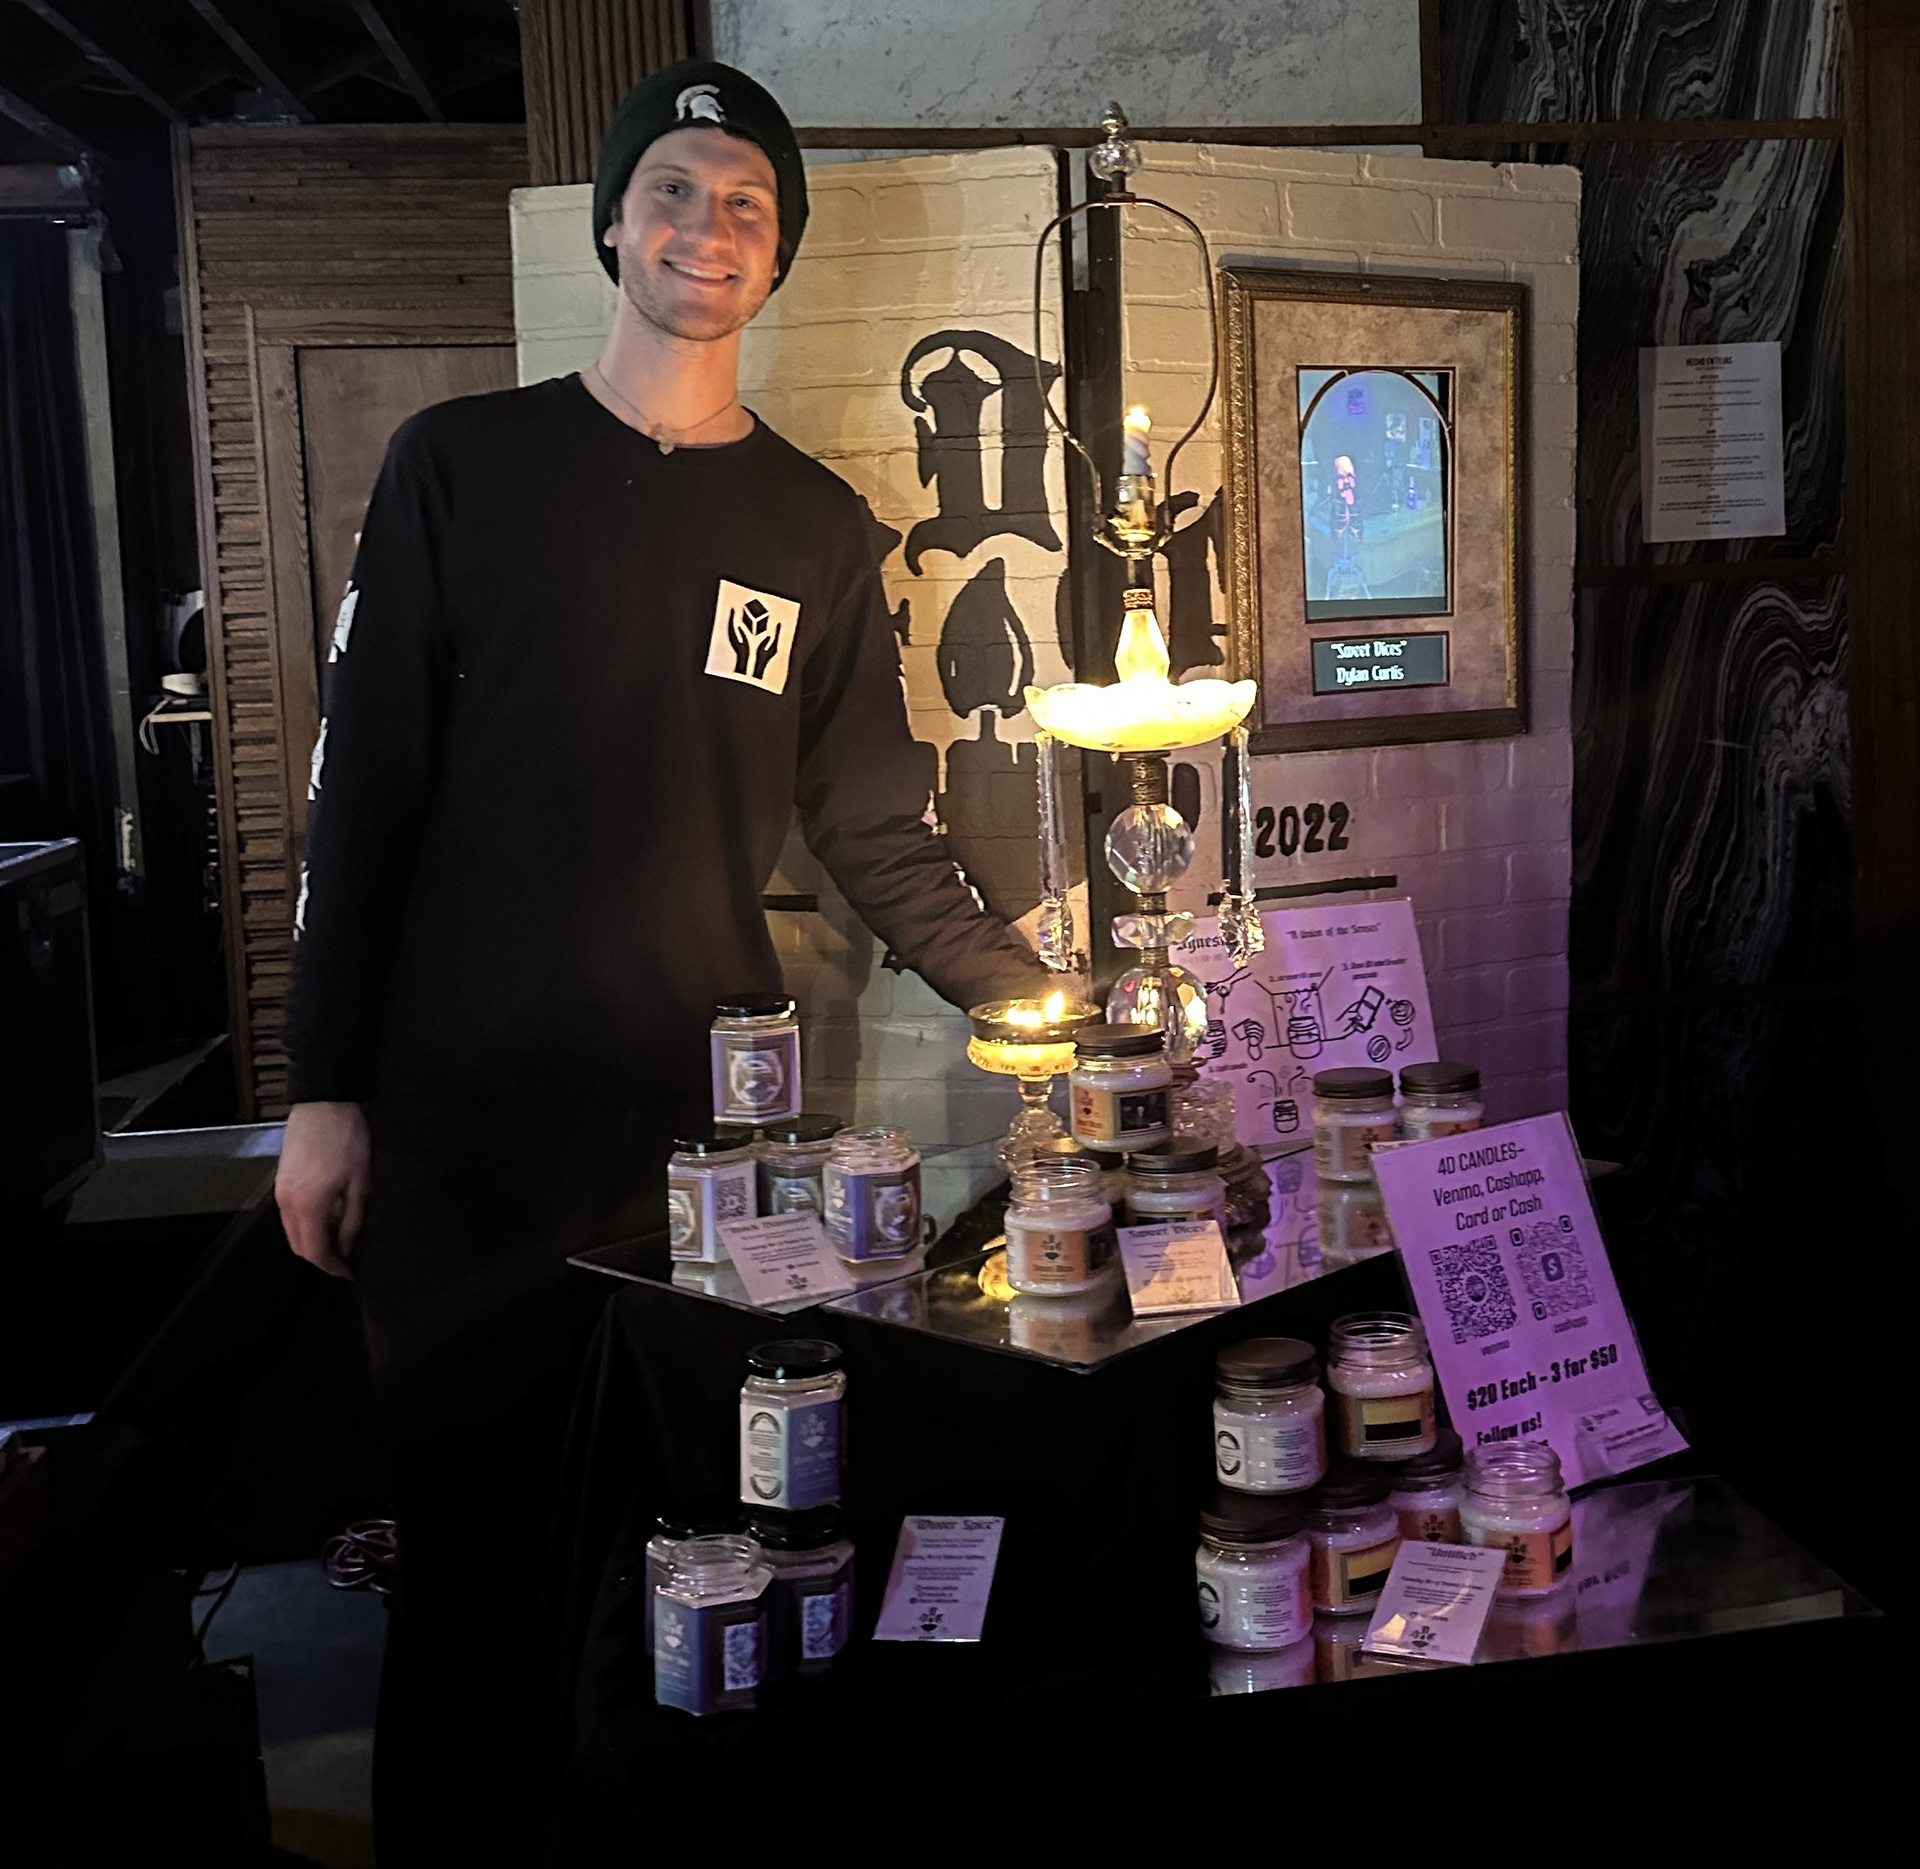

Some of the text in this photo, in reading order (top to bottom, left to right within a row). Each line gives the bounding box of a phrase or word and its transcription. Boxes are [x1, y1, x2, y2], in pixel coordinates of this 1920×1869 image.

[1336, 665, 1404, 686] Dylan Curtis
[1256, 802, 1349, 858] 2022
[1438, 1156, 1456, 1174] 4D
[1433, 1169, 1545, 1206] Venmo, Cashapp,
[1456, 1194, 1542, 1230] Card or Cash
[1468, 1383, 1498, 1410] $20
[1501, 1371, 1537, 1400] Each
[1550, 1362, 1561, 1383] 3
[1564, 1357, 1588, 1379] for
[1590, 1344, 1618, 1370] $50
[1477, 1411, 1542, 1446] Follow us!
